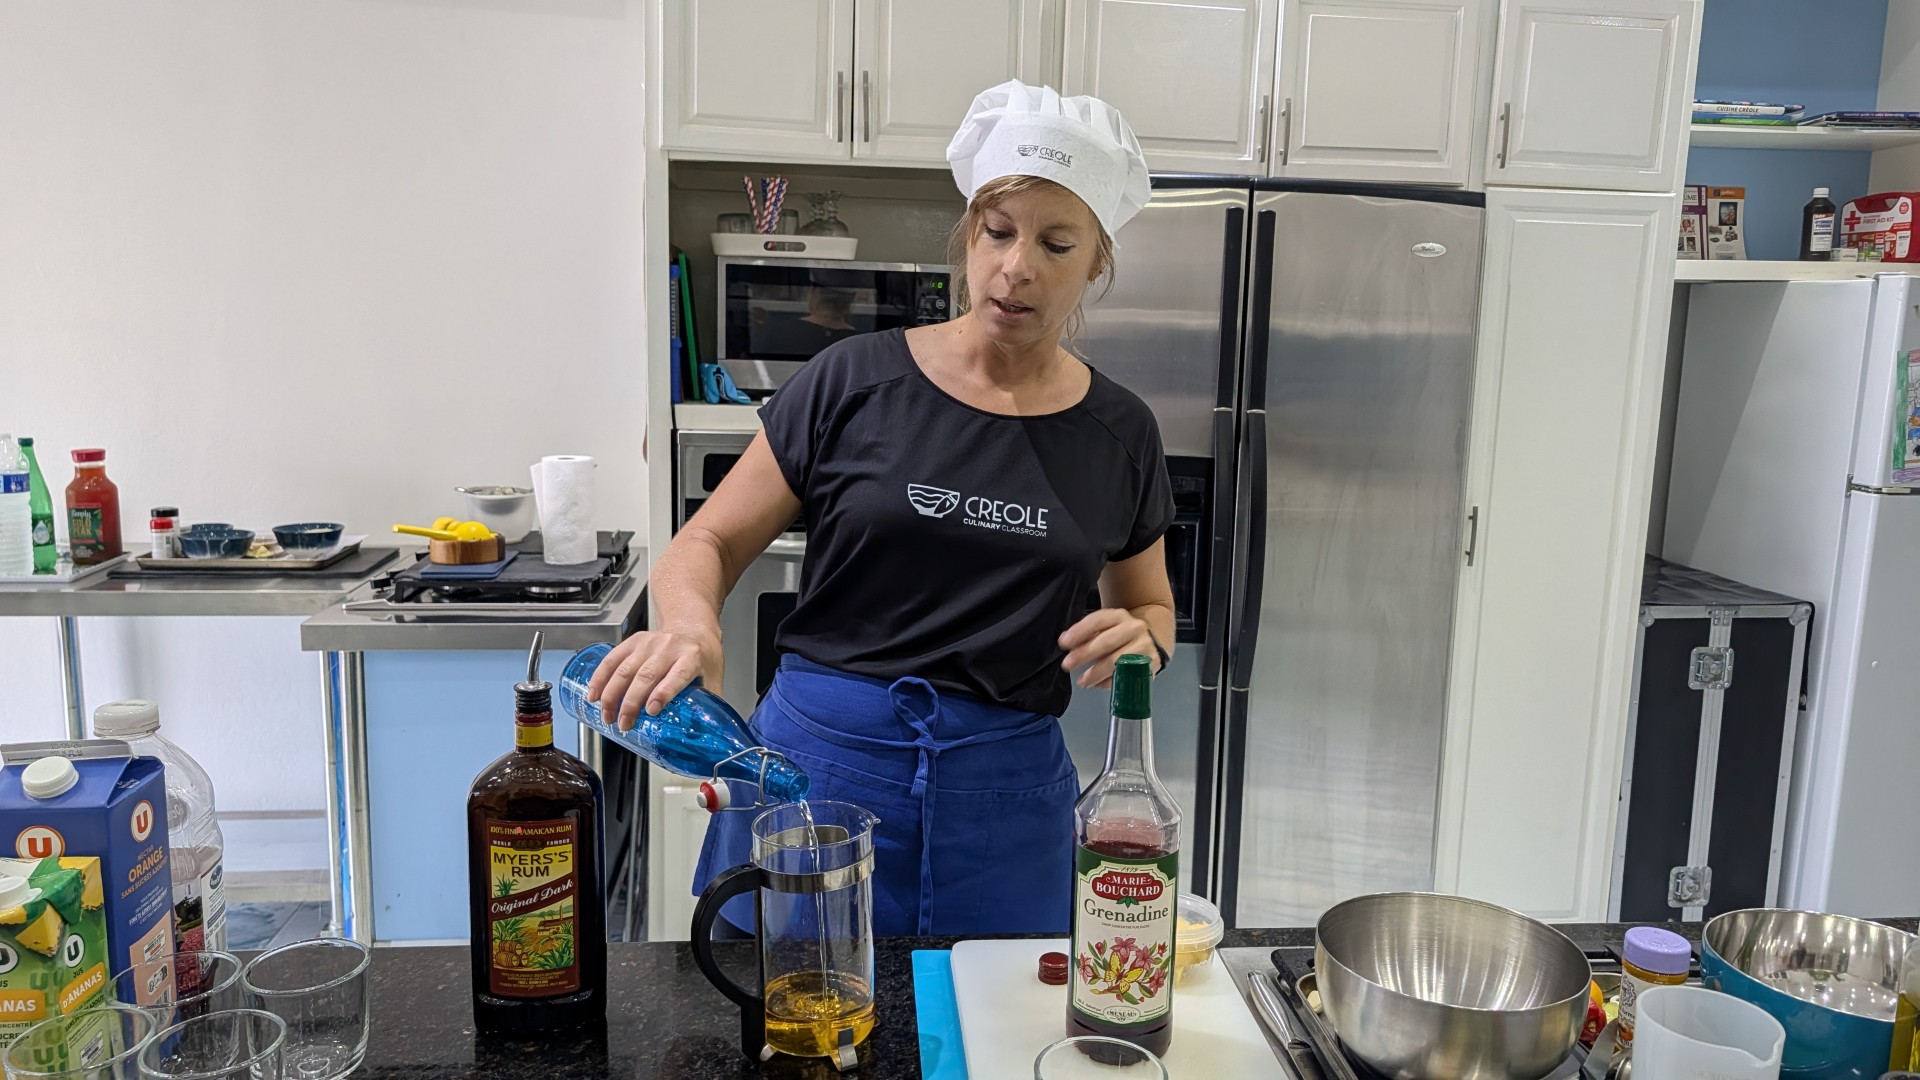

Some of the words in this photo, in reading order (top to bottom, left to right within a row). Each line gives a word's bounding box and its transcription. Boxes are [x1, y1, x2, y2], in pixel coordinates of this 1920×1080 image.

[1716, 105, 1738, 113] CUISINE
[1040, 146, 1073, 165] CREOLE
[965, 496, 1049, 530] CREOLE
[963, 518, 1001, 530] CULINARY
[1001, 524, 1047, 538] CLASSROOM
[136, 809, 149, 834] U
[556, 824, 572, 833] RUM
[28, 837, 52, 858] U
[546, 838, 570, 846] FAMOUS
[128, 846, 163, 883] ORANGE
[493, 850, 569, 866] MYERS'S
[511, 865, 550, 878] RUM
[1112, 875, 1147, 885] MARIE
[121, 885, 135, 899] SANS
[491, 892, 540, 914] Original
[540, 878, 574, 901] Dark
[1096, 882, 1160, 897] BOUCHARD
[1084, 898, 1169, 923] Grenadine
[67, 940, 80, 962] U
[73, 967, 84, 978] JUS
[62, 970, 103, 1008] D'ANANAS
[0, 999, 37, 1012] NAS
